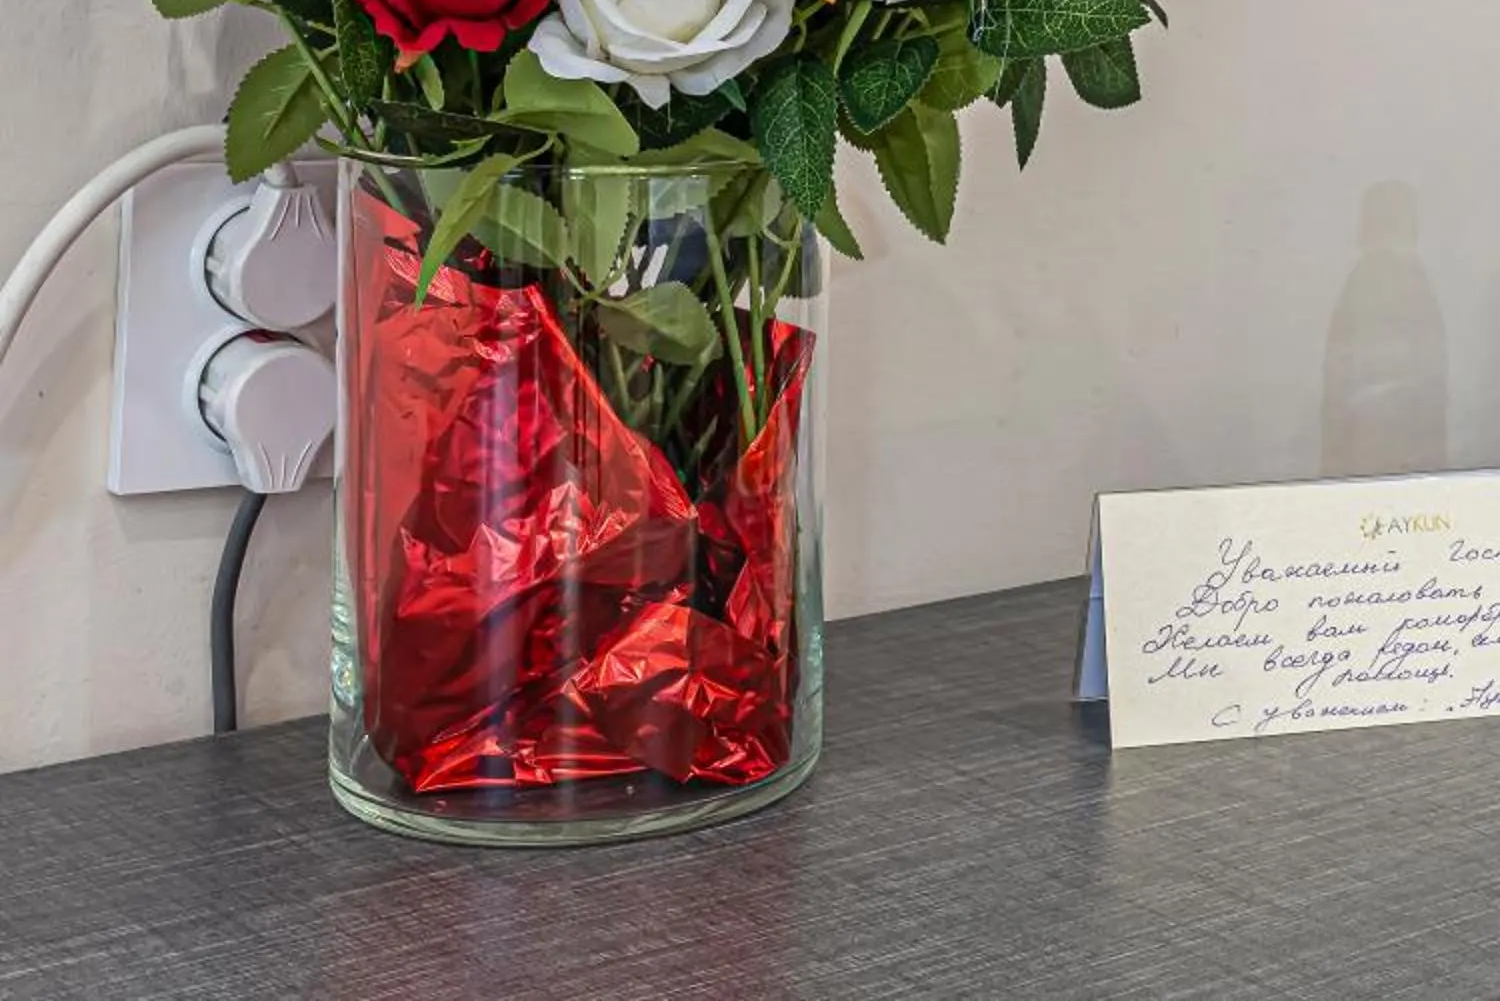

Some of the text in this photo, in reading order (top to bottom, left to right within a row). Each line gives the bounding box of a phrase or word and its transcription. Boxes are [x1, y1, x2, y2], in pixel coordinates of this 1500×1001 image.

[1387, 515, 1451, 534] AYKUN
[1175, 584, 1280, 632] Добро
[1308, 576, 1482, 609] пожаловать
[1142, 623, 1273, 654] Желаем
[1147, 656, 1225, 684] Мы
[1262, 644, 1352, 698] всегда
